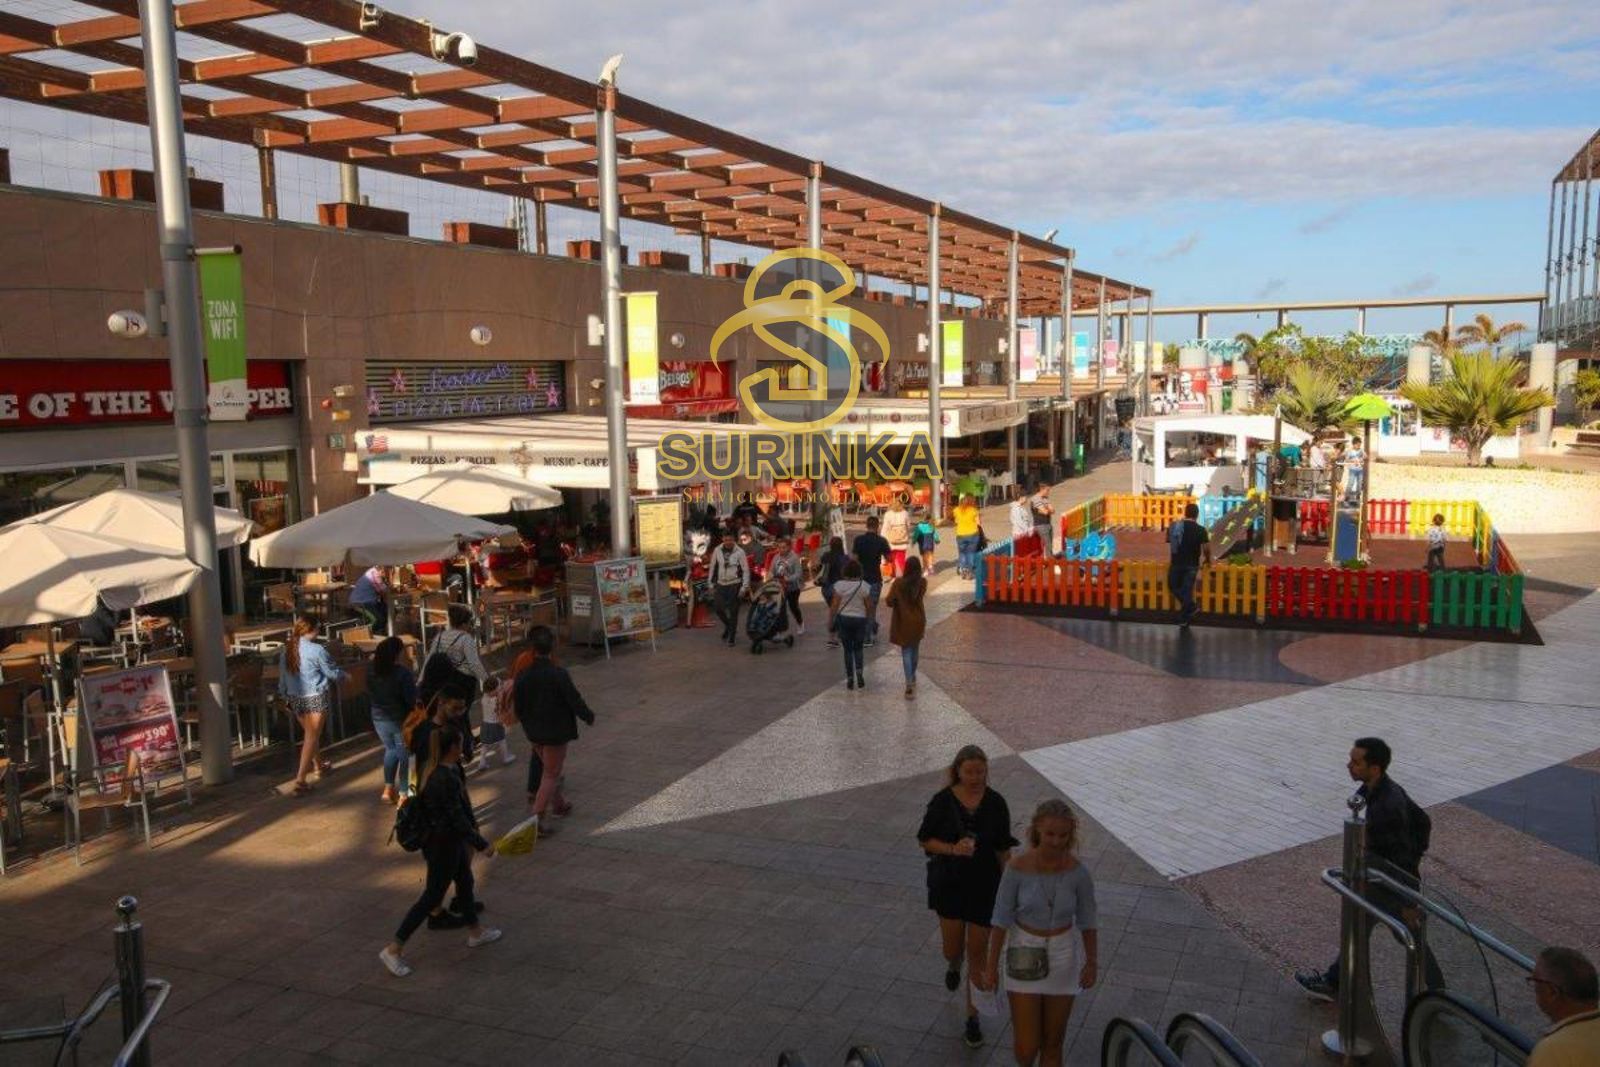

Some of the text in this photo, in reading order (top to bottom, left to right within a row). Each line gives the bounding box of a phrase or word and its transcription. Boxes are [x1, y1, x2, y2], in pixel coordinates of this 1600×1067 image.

[206, 300, 237, 318] ZONA
[209, 318, 237, 340] WIFI
[28, 392, 76, 419] OF
[84, 390, 152, 416] THE
[410, 455, 447, 465] PIZZAS
[543, 456, 575, 467] MUSIC
